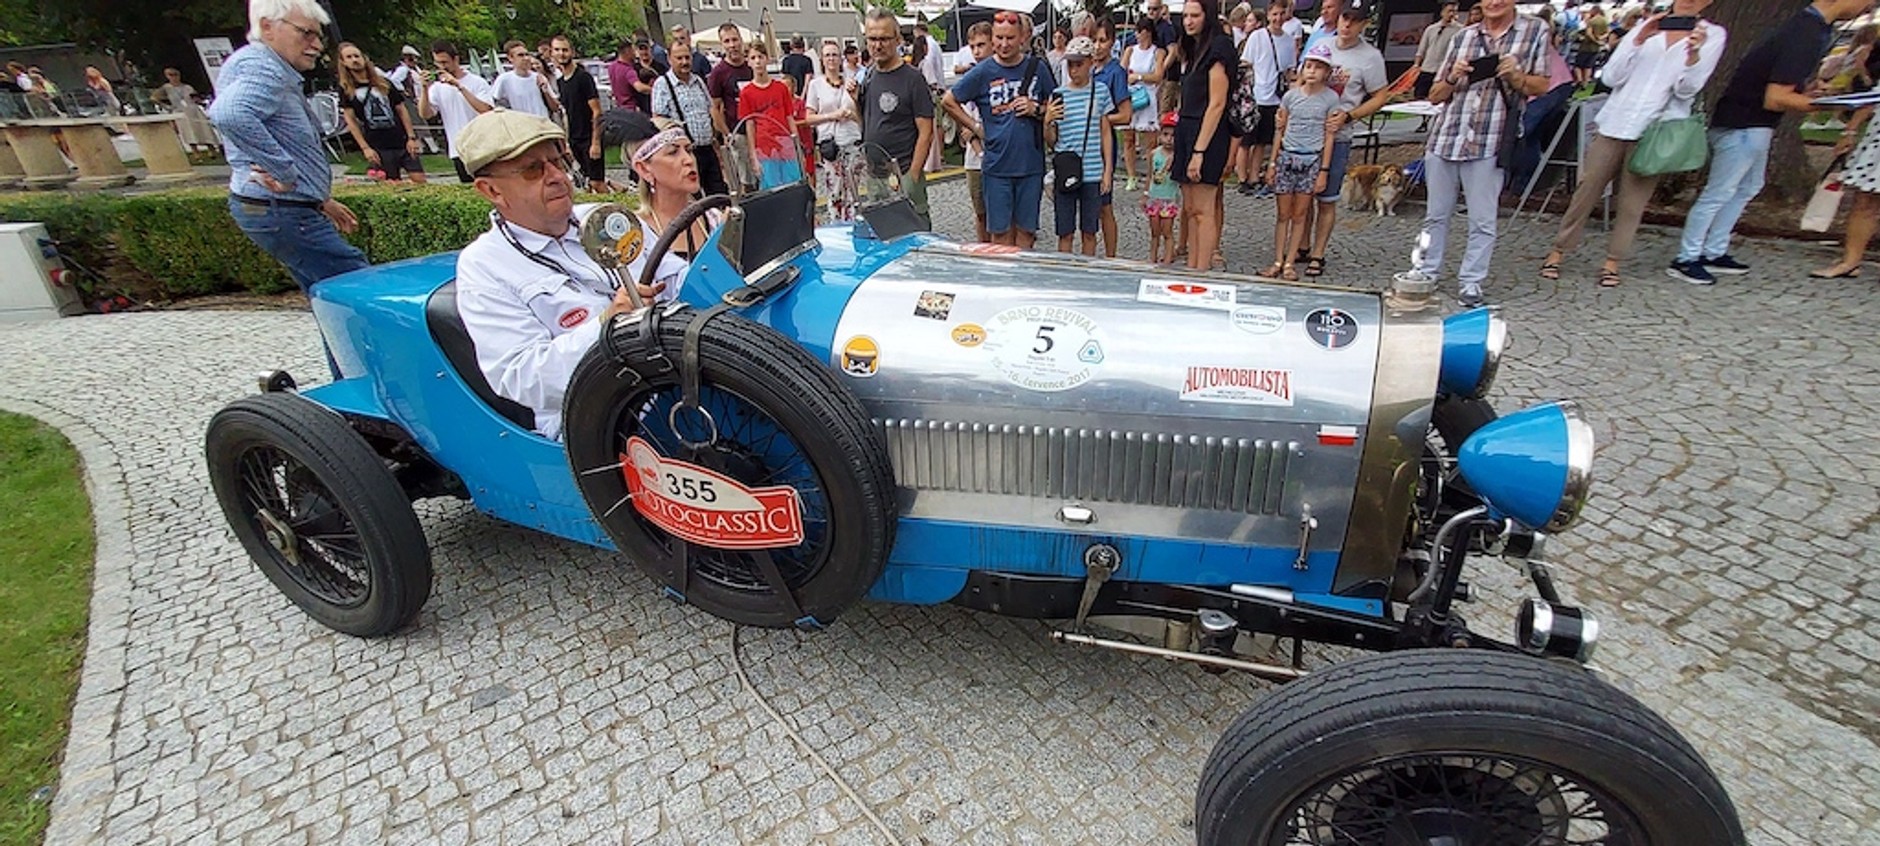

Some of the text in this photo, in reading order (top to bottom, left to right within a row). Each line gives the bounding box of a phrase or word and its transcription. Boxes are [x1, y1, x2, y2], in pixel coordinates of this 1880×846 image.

[998, 306, 1098, 335] BRNO REVIVAL
[1032, 325, 1055, 354] 5
[1067, 367, 1091, 385] 2017
[1182, 366, 1290, 401] AUTOMOBILISTA
[666, 473, 718, 503] 355
